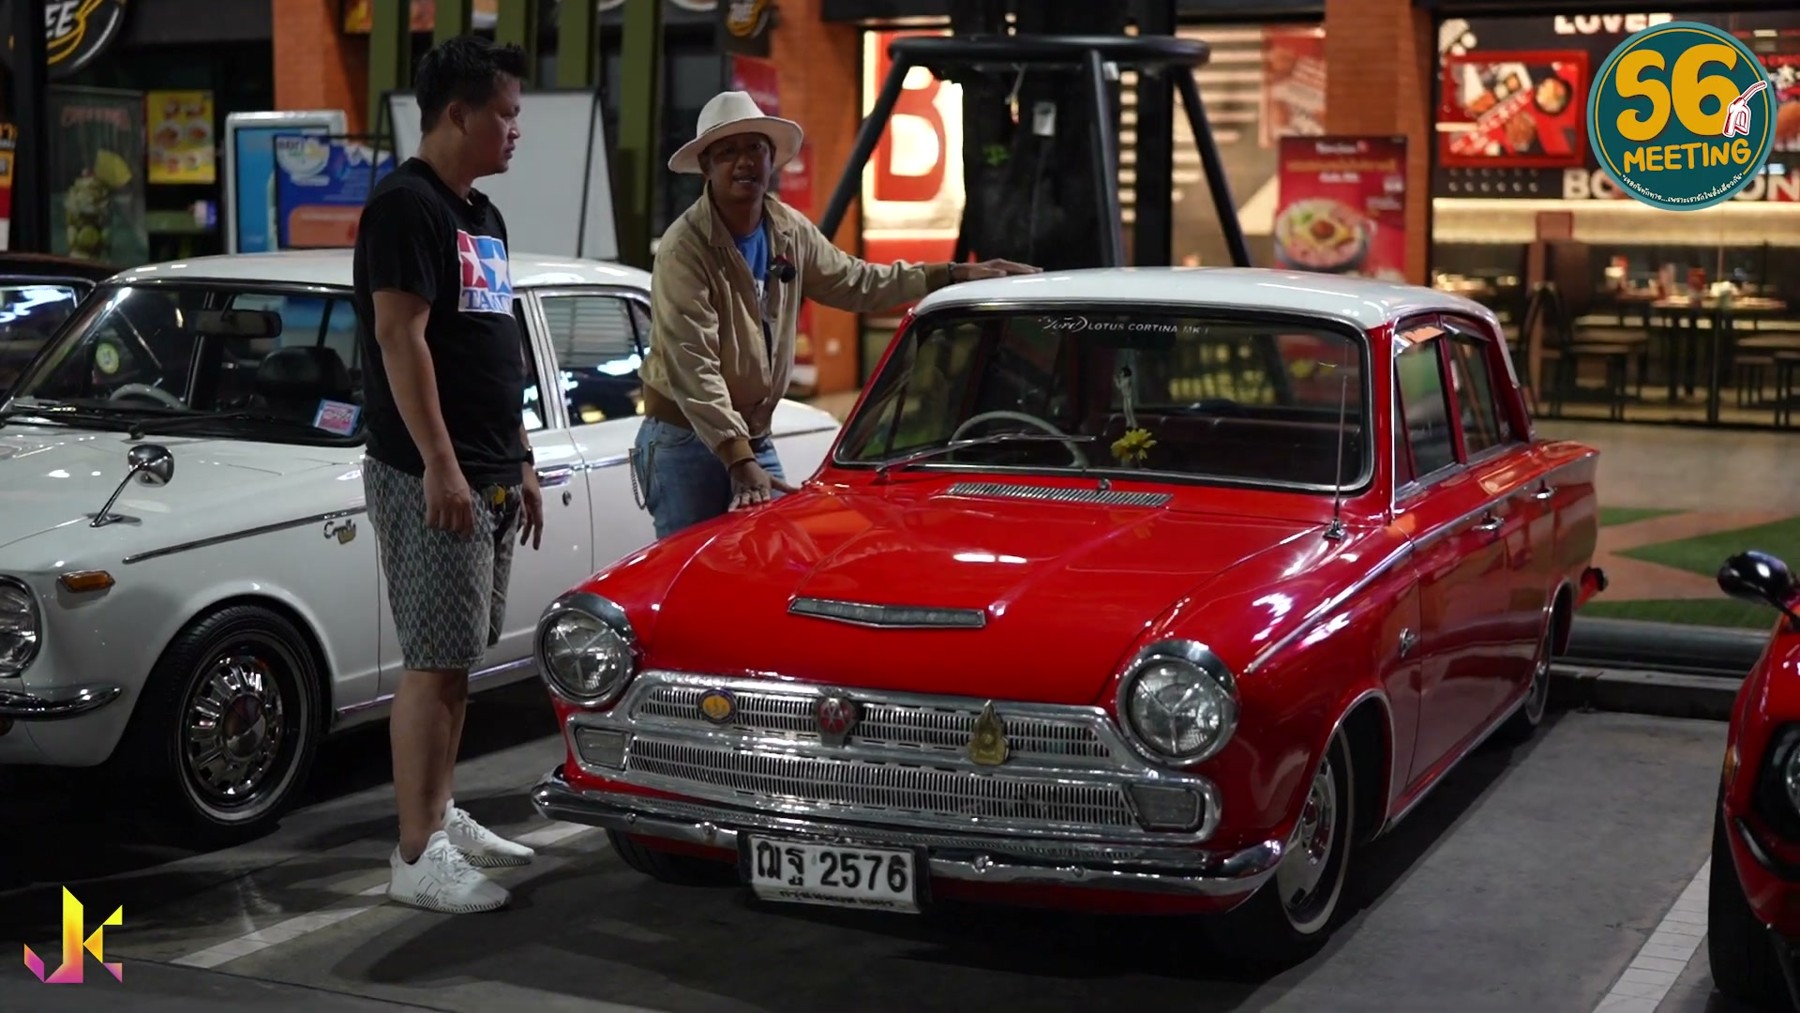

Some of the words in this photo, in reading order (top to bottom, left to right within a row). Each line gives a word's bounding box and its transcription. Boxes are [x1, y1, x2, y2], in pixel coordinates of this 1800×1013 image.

[1088, 322, 1125, 332] LOTUS
[1128, 323, 1178, 333] CORTINA
[819, 851, 908, 893] 2576
